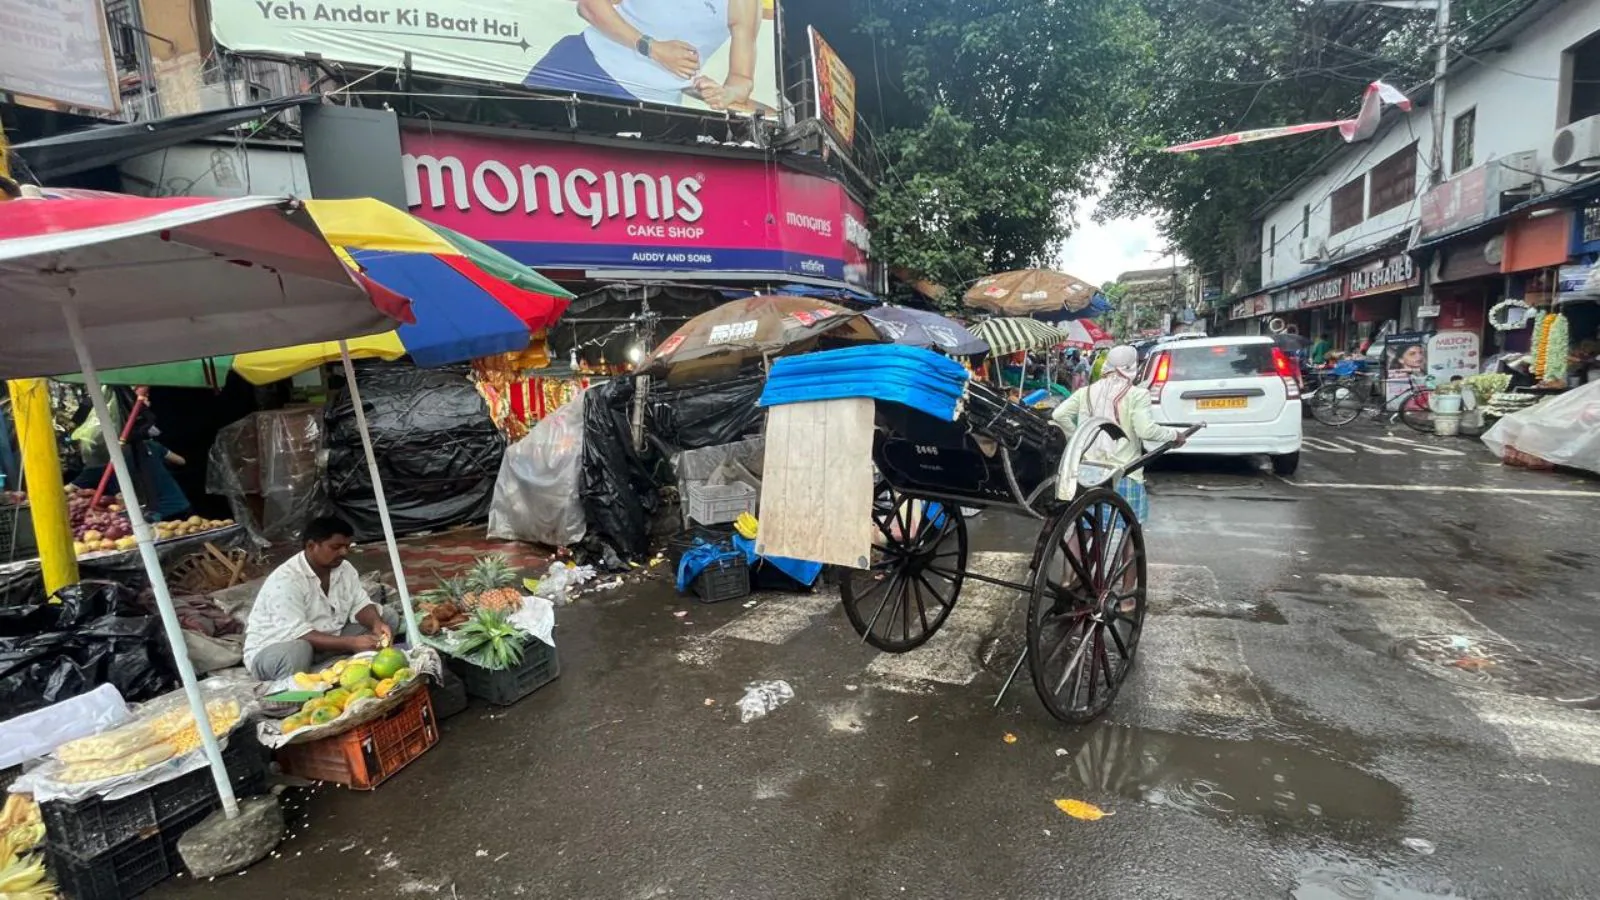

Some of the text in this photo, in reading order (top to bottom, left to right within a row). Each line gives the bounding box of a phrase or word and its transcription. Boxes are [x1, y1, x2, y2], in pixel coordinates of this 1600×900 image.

[257, 1, 518, 37] Yeh Andar Ki Baat Hai
[627, 224, 704, 238] CAKE SHOP
[632, 252, 712, 263] AUDDY AND SONS
